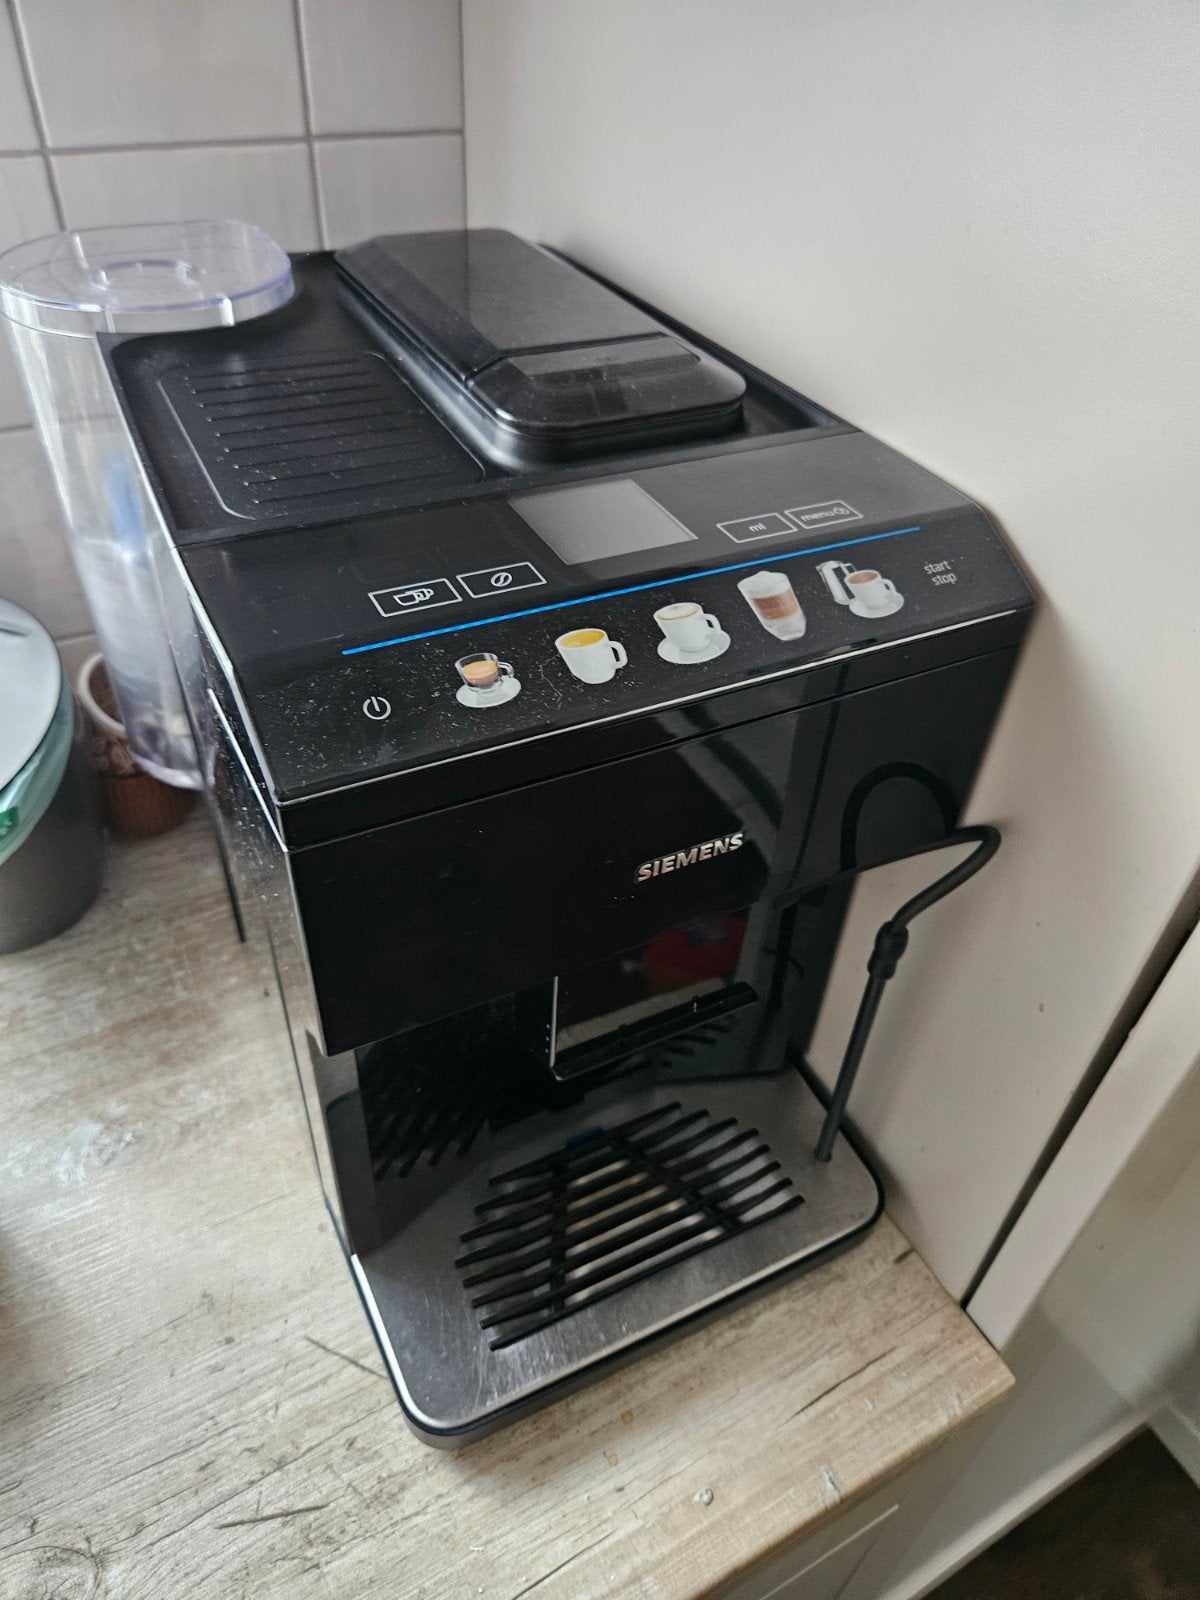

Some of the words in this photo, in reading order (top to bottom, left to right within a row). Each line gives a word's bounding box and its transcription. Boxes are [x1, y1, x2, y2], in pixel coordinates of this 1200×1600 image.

[800, 509, 835, 522] menu
[748, 522, 766, 532] ml
[923, 559, 951, 575] start
[931, 572, 957, 586] stop
[637, 832, 744, 882] SIEMENS
